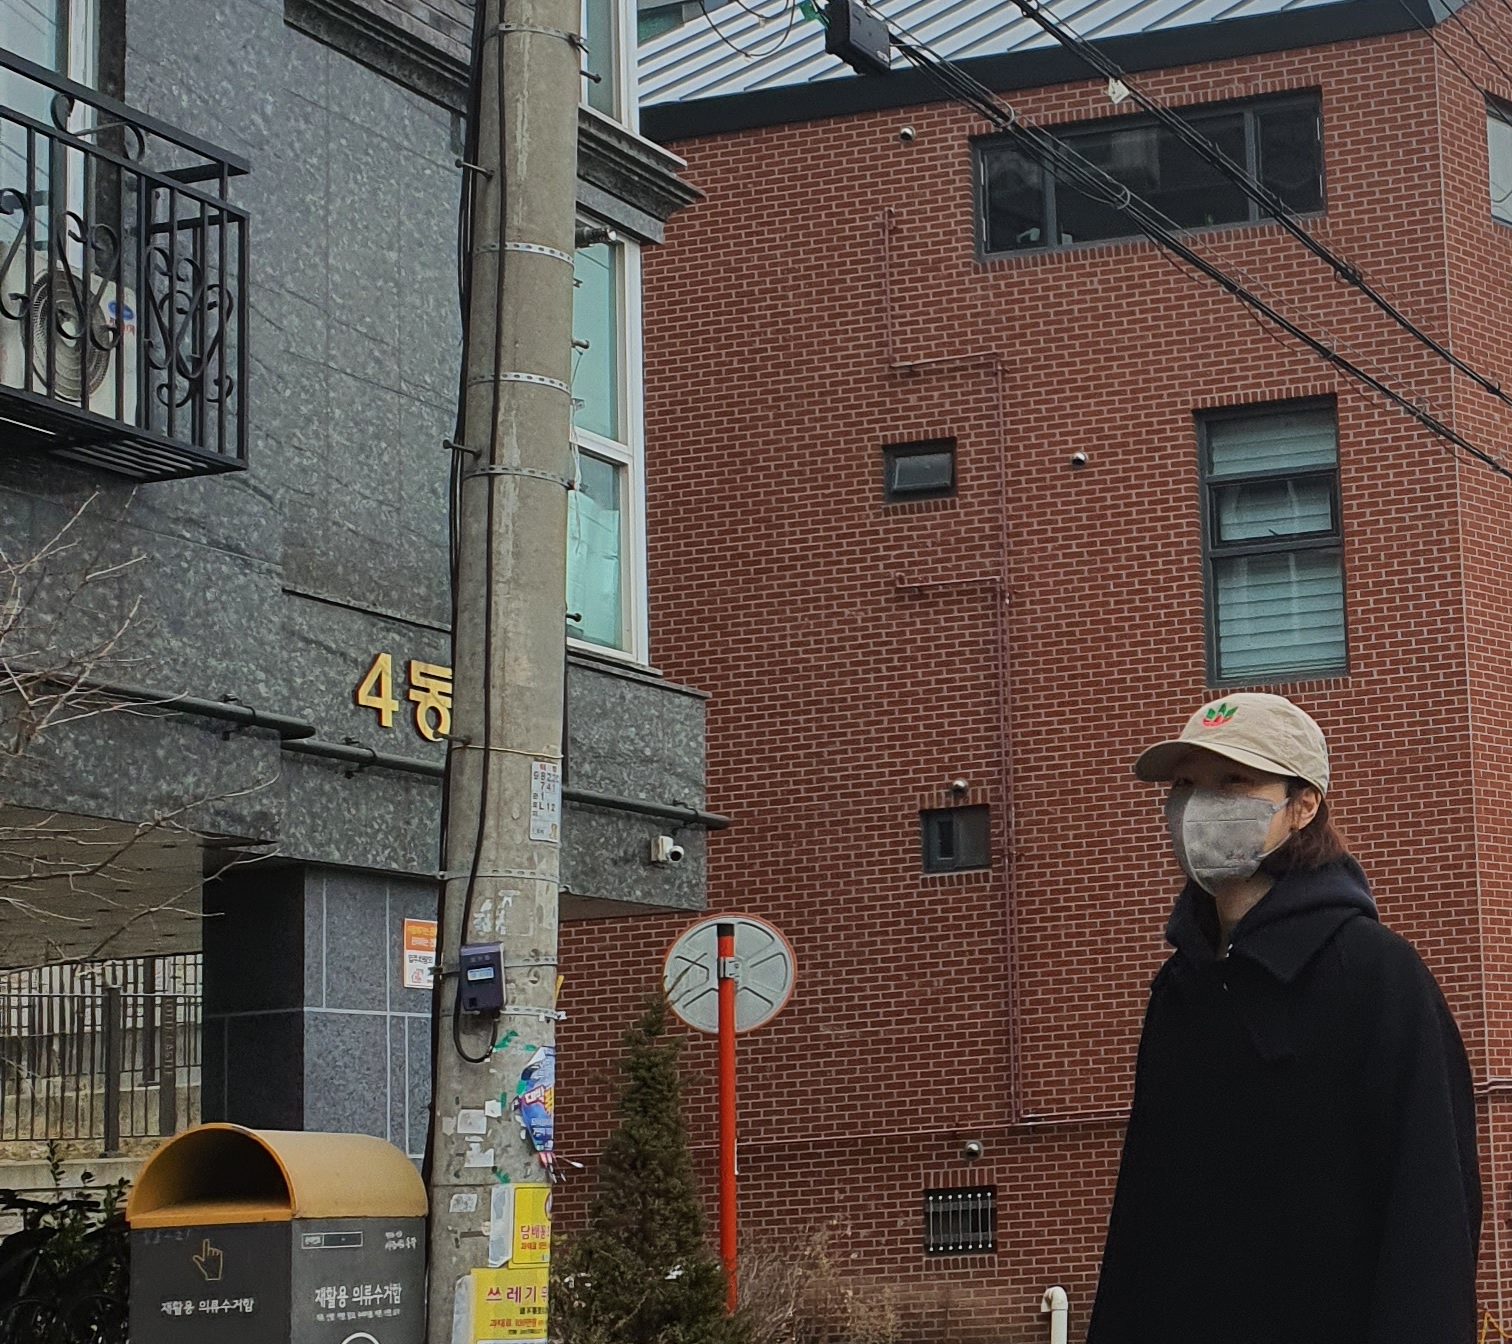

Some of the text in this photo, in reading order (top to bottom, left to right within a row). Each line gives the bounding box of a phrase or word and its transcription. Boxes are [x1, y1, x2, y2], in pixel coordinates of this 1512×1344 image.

[357, 652, 453, 742] 4동
[160, 1297, 255, 1316] 재활용 의류수거함
[314, 1282, 402, 1309] 재활용 의류수거함
